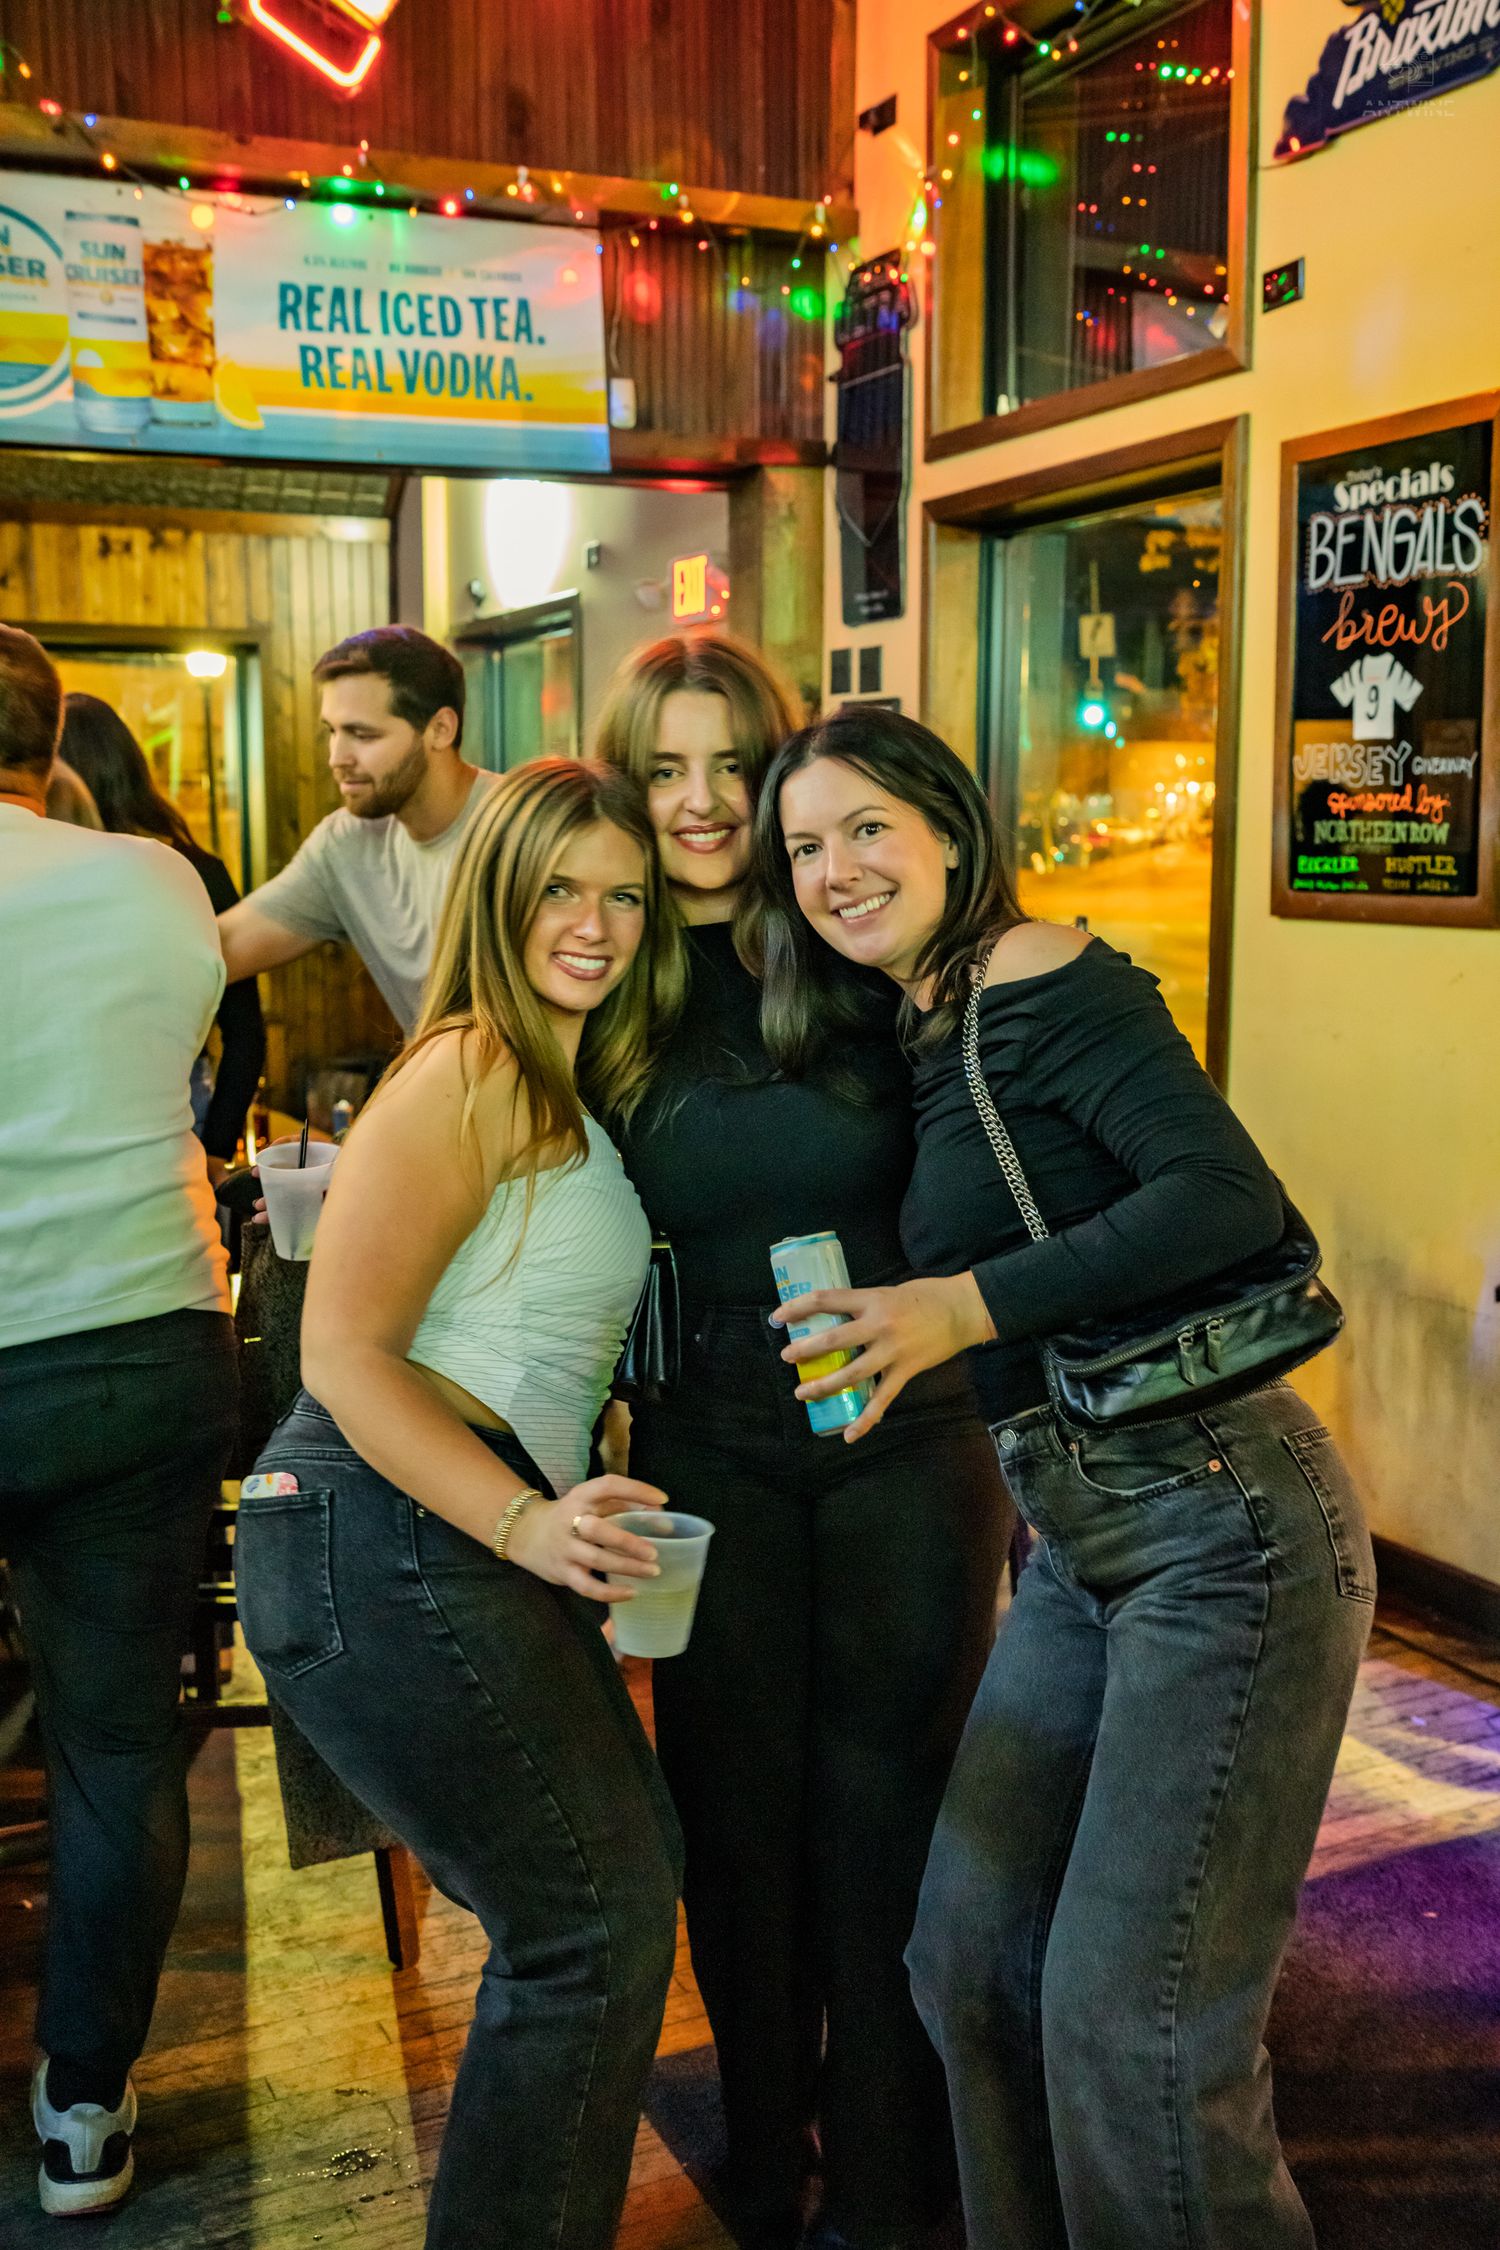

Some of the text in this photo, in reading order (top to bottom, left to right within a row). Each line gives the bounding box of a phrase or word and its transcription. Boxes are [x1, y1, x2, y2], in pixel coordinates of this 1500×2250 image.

[1332, 0, 1500, 109] Braxton
[278, 282, 546, 346] REAL ICED TEA.
[298, 344, 533, 402] REAL VODKA.
[1333, 461, 1456, 513] Specials
[1308, 497, 1486, 590] BENGALS
[1366, 684, 1380, 720] 9
[1292, 739, 1413, 788] JERSEY
[1313, 819, 1450, 845] NORTHERN ROW
